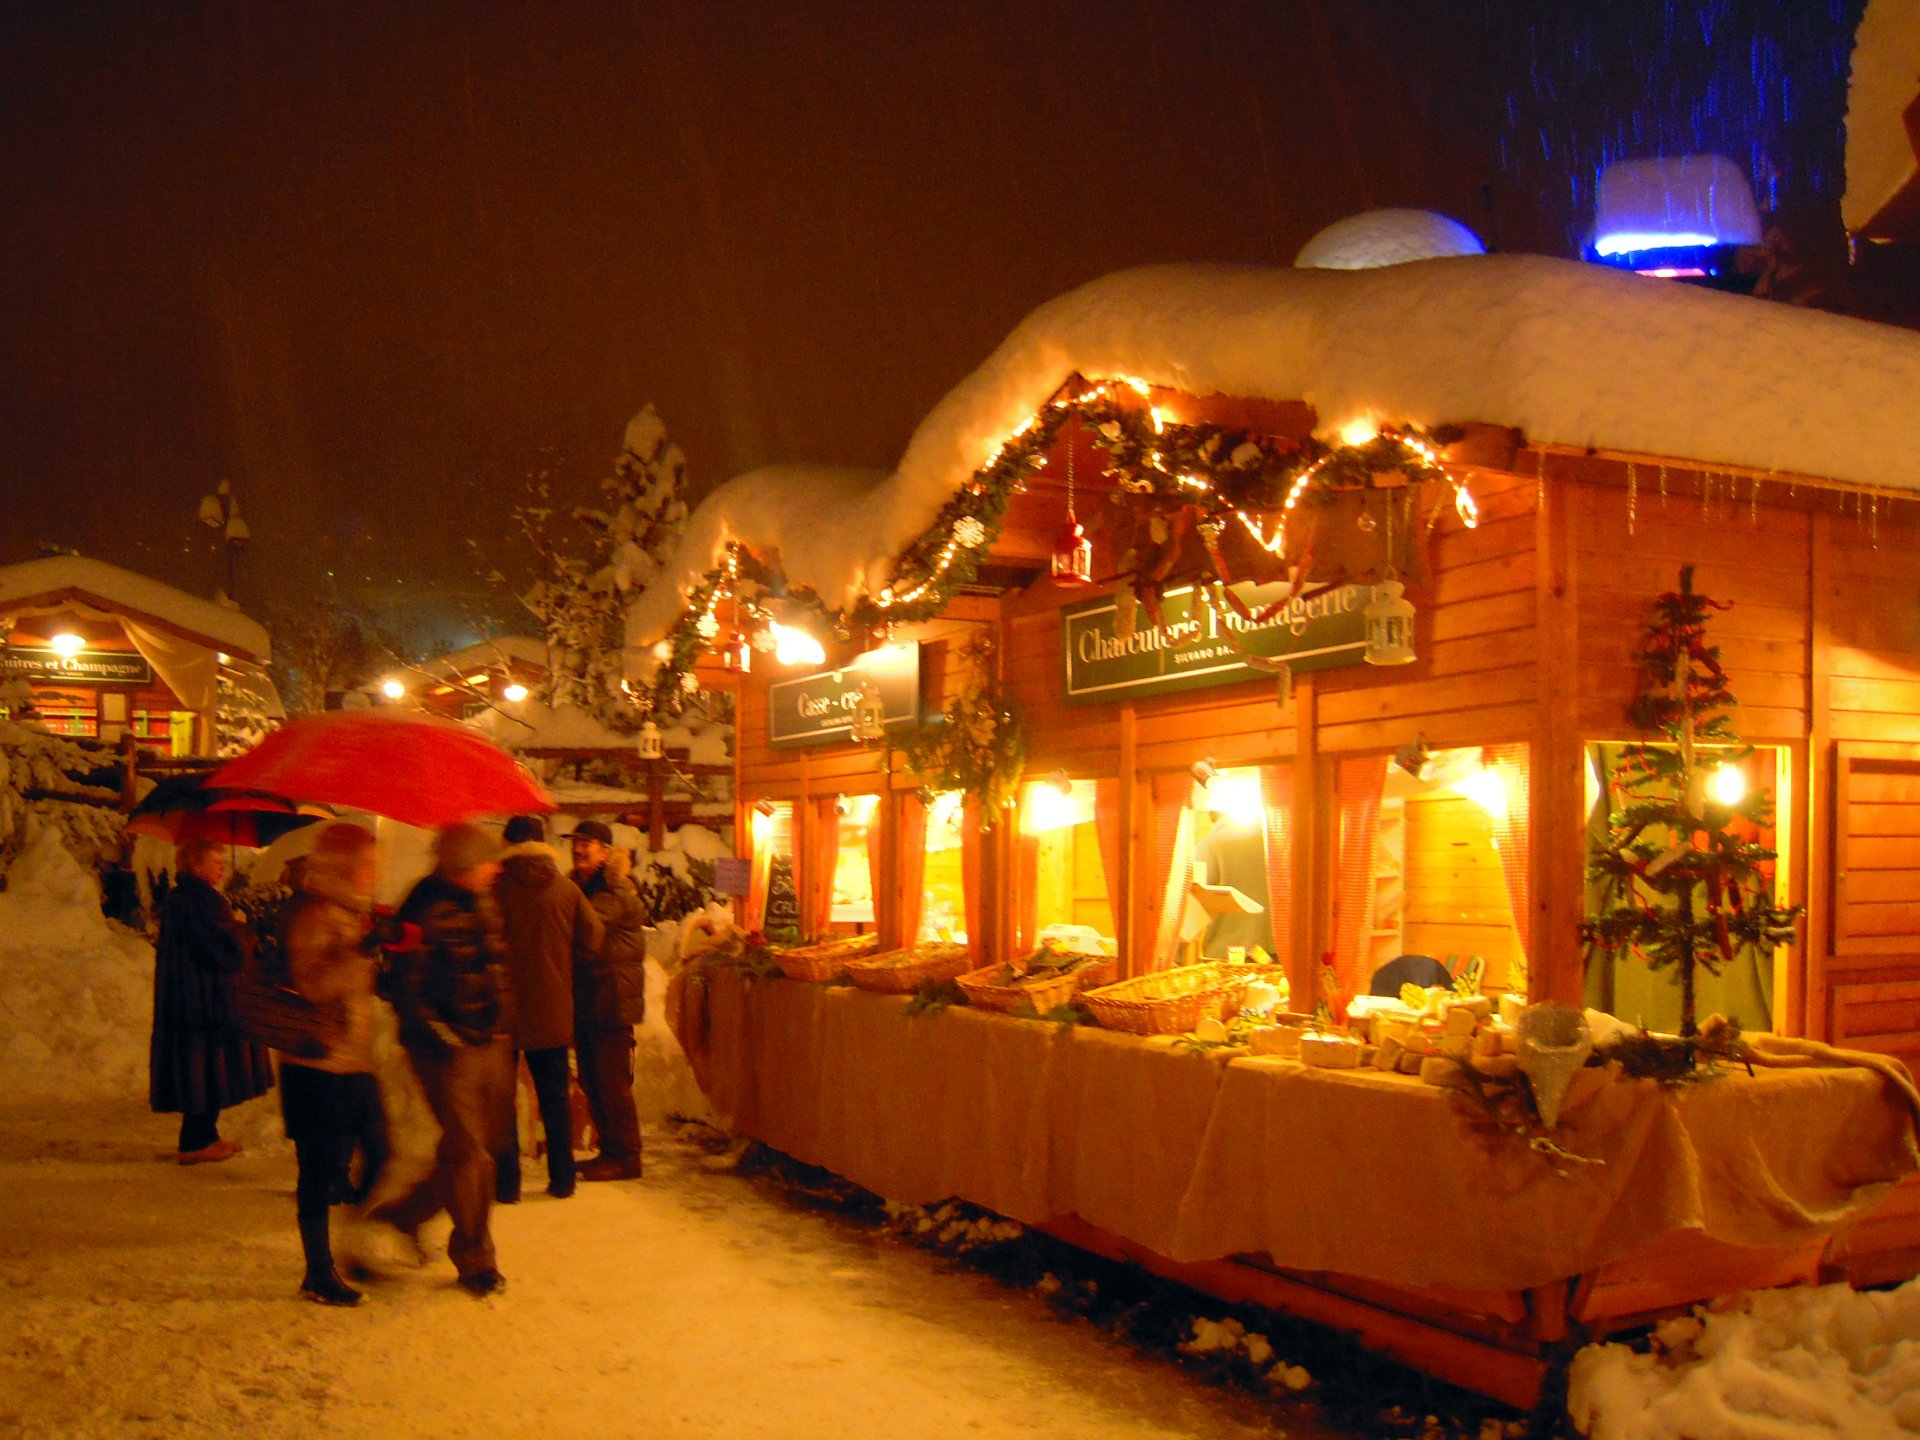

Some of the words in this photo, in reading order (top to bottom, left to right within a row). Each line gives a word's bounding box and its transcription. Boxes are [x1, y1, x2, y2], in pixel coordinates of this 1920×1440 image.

[1, 655, 43, 670] uîtres
[45, 660, 59, 671] et
[61, 658, 142, 676] Champagne
